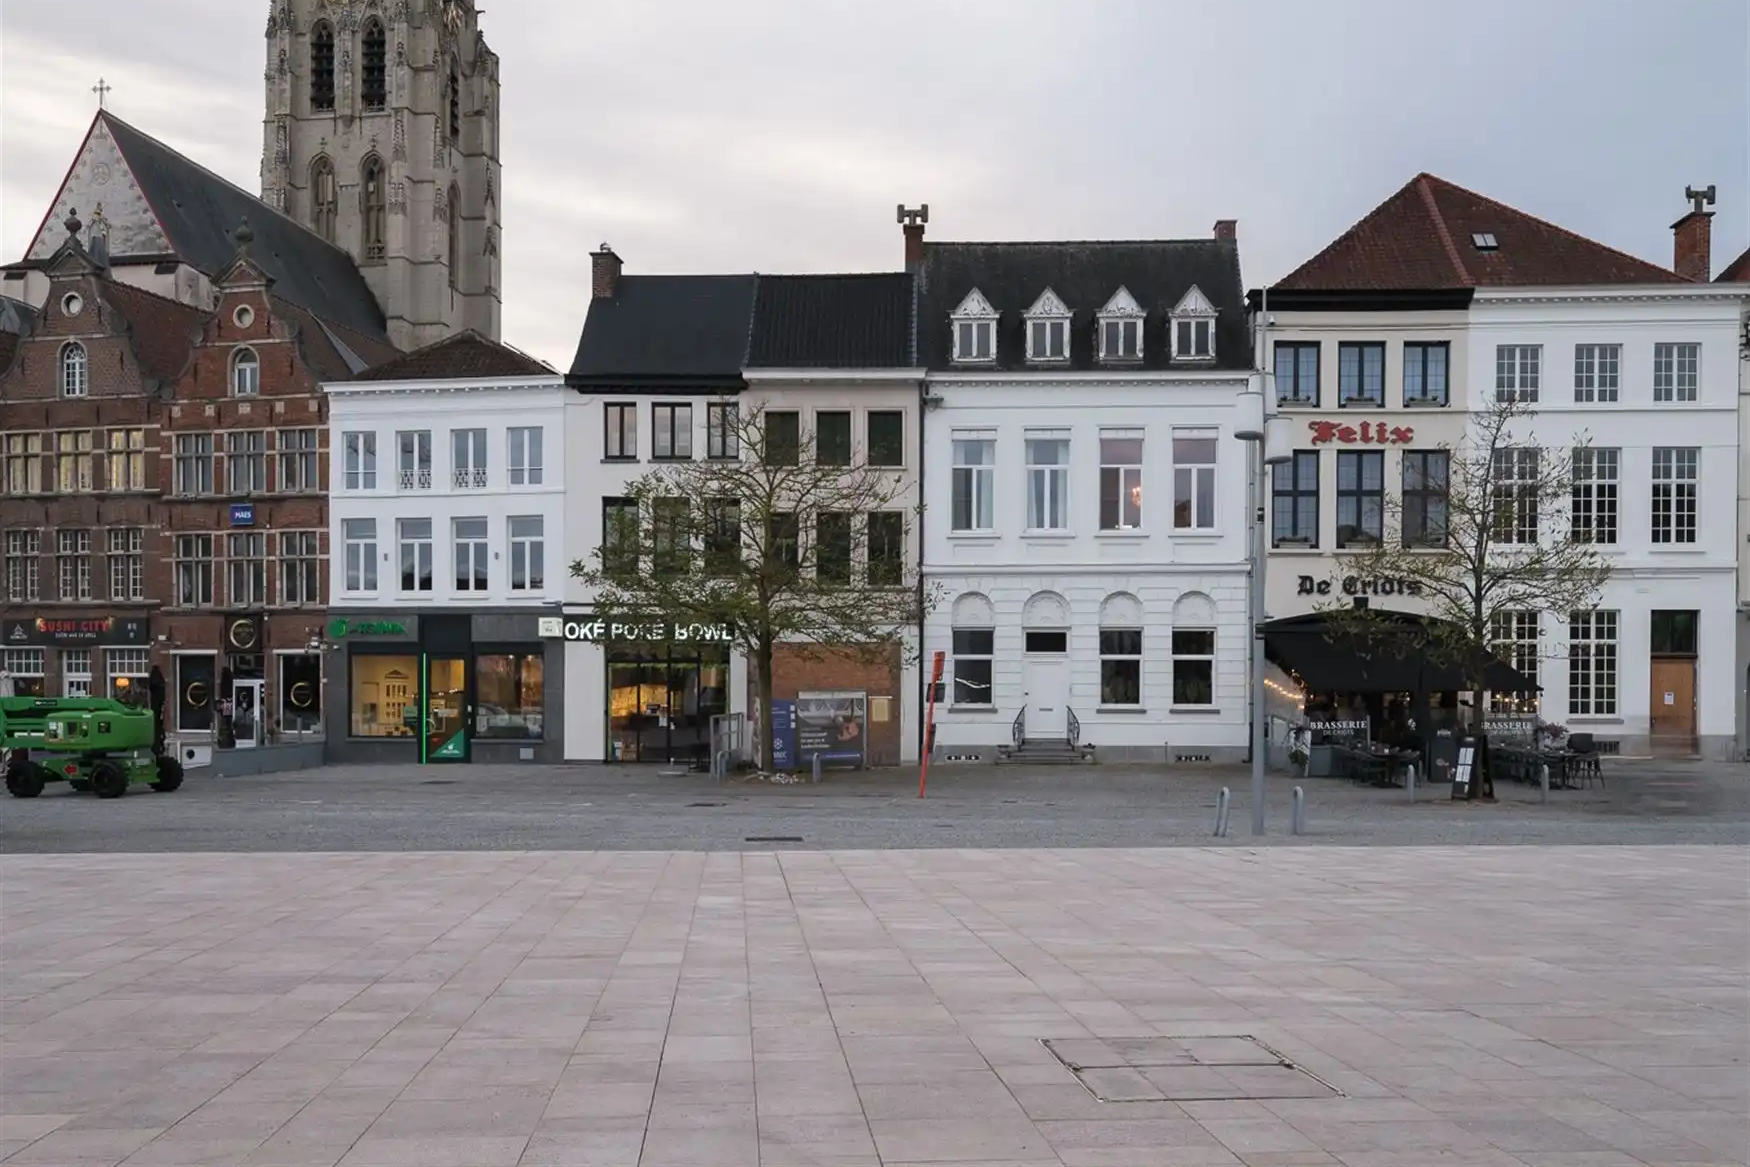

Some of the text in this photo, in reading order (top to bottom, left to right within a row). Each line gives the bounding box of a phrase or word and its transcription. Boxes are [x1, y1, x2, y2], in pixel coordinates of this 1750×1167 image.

[1308, 420, 1415, 446] Felix
[1297, 575, 1331, 595] De
[40, 620, 110, 632] SUSHI CITY
[565, 618, 605, 640] OKÉ
[1310, 720, 1368, 730] BRASSERIE
